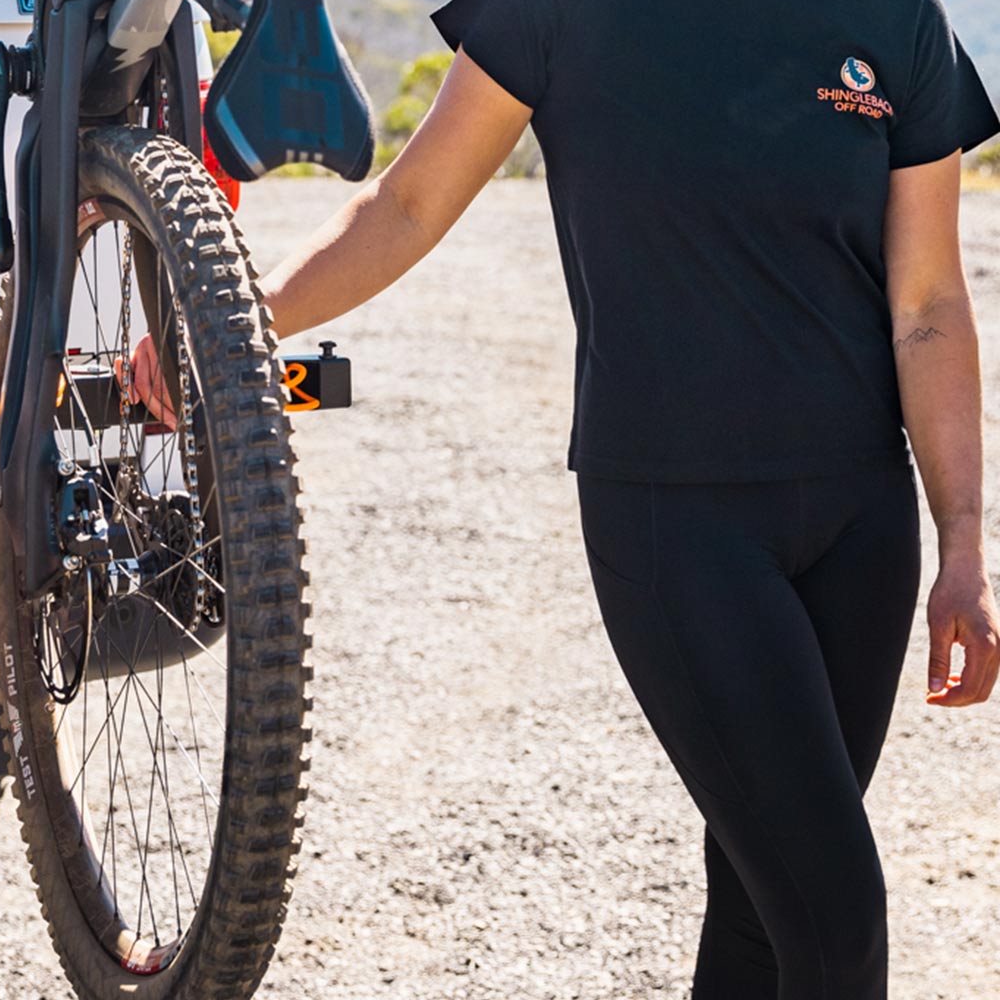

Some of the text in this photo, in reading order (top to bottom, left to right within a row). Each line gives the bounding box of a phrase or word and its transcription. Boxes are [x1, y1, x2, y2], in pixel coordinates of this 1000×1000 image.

[834, 101, 857, 112] OFF
[3, 642, 37, 800] TEST PILOT
